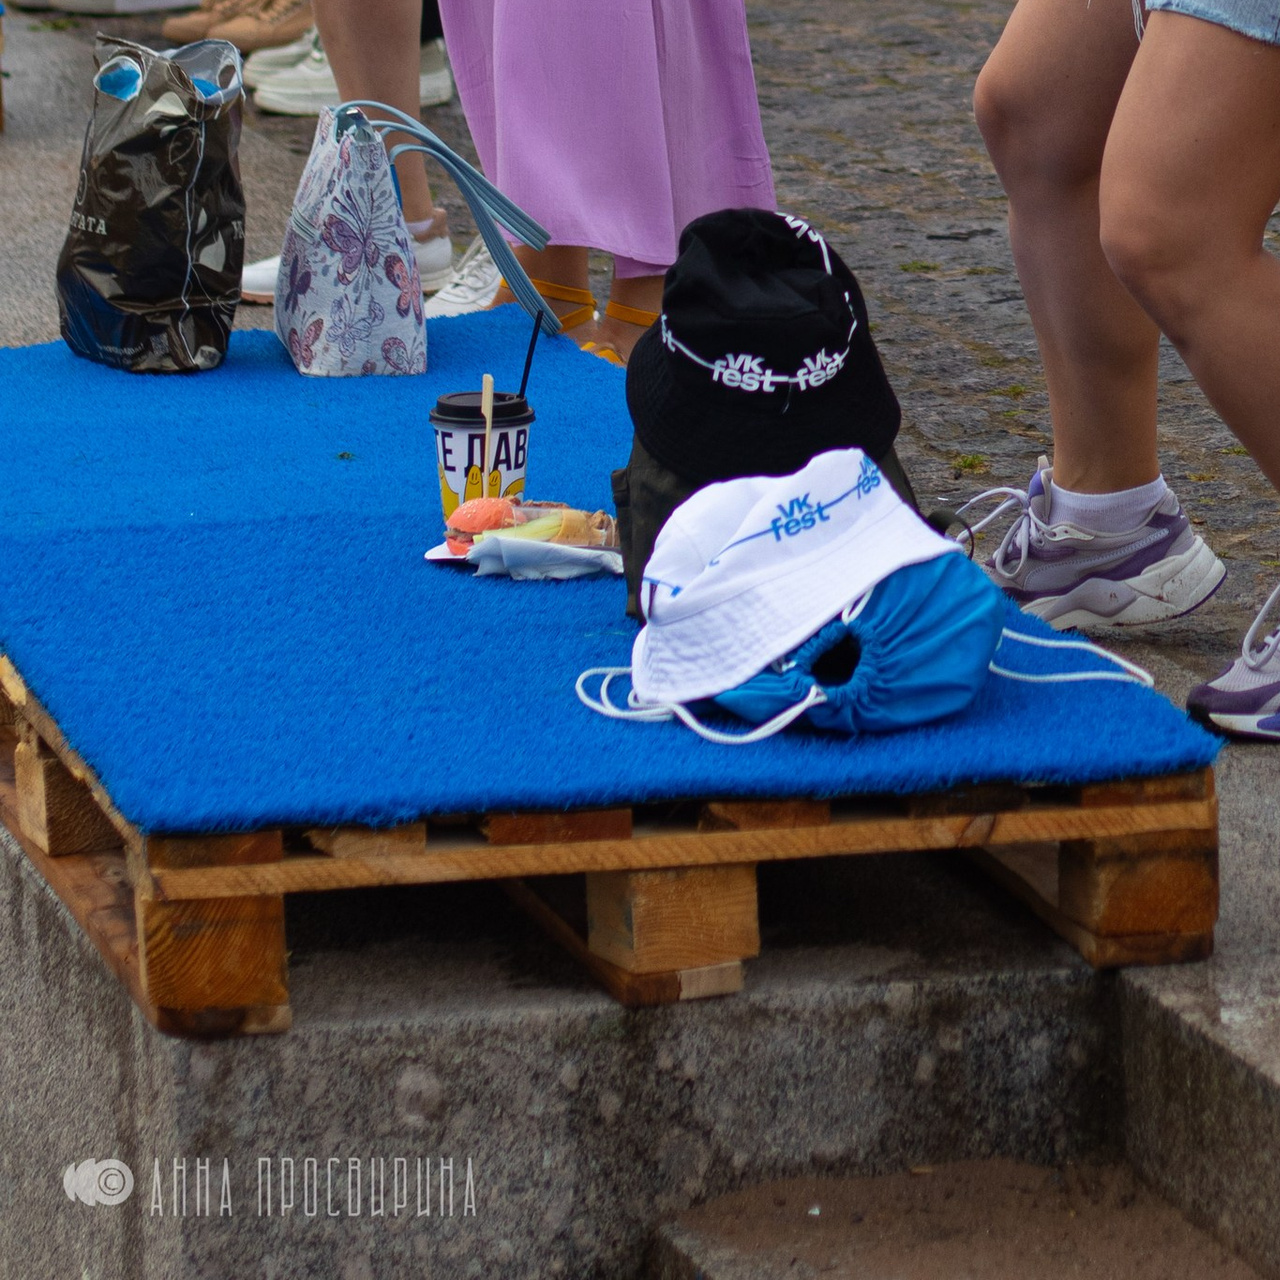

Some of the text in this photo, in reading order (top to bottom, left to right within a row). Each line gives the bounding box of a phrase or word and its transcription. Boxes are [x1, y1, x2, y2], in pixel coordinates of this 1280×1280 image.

[712, 358, 777, 393] fest
[725, 352, 766, 374] VK
[796, 352, 846, 391] fest
[857, 473, 881, 501] fes
[776, 492, 814, 520] VK
[770, 501, 831, 543] fest
